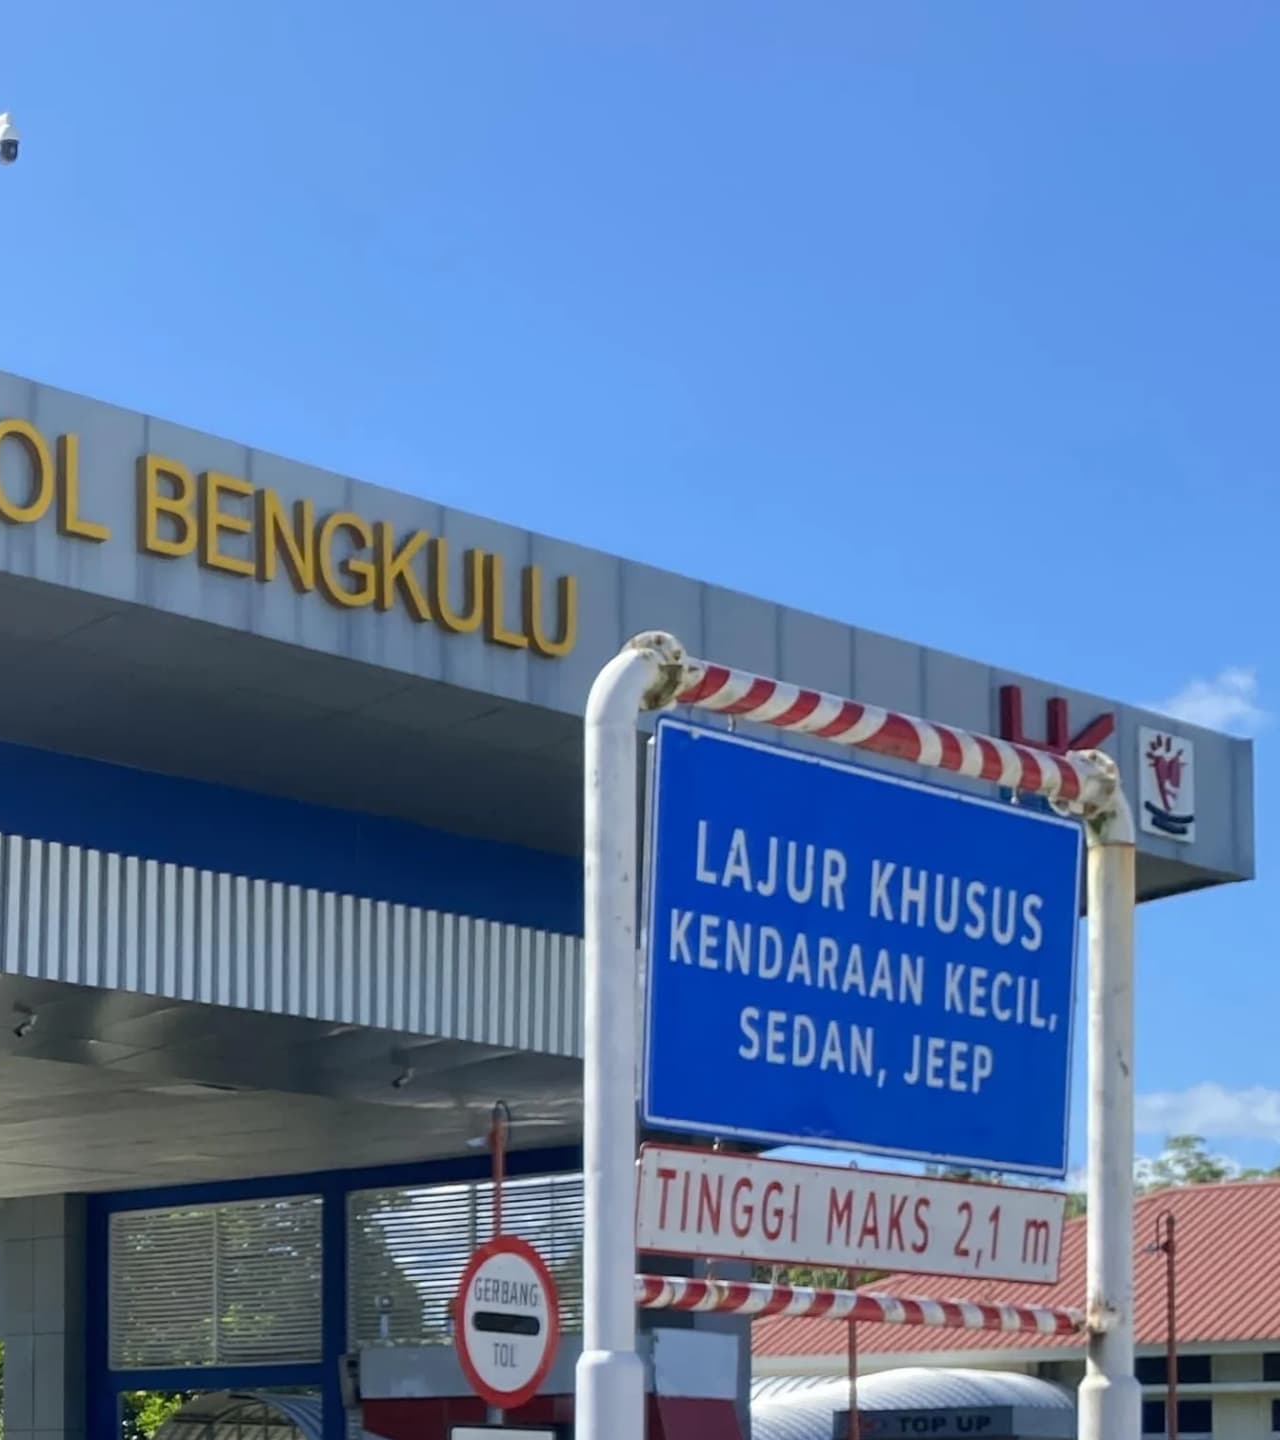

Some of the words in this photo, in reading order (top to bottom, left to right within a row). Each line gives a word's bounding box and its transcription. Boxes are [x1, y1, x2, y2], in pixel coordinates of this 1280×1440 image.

[137, 451, 578, 659] BENGKULU
[696, 820, 847, 911] LAJUR
[870, 861, 1044, 952] KHUSUS
[669, 908, 925, 1006] KENDARAAN
[944, 960, 1058, 1033] KECIL,
[739, 1006, 886, 1089] SEDAN,
[903, 1033, 993, 1094] JEEP
[656, 1167, 800, 1243] TINGGI
[827, 1186, 930, 1255] MAKS
[953, 1202, 1001, 1269] 2,1
[1022, 1219, 1051, 1265] m
[474, 1277, 538, 1307] GERBANG
[493, 1342, 517, 1368] TOL
[899, 1416, 947, 1433] TOP
[956, 1415, 991, 1432] UP
